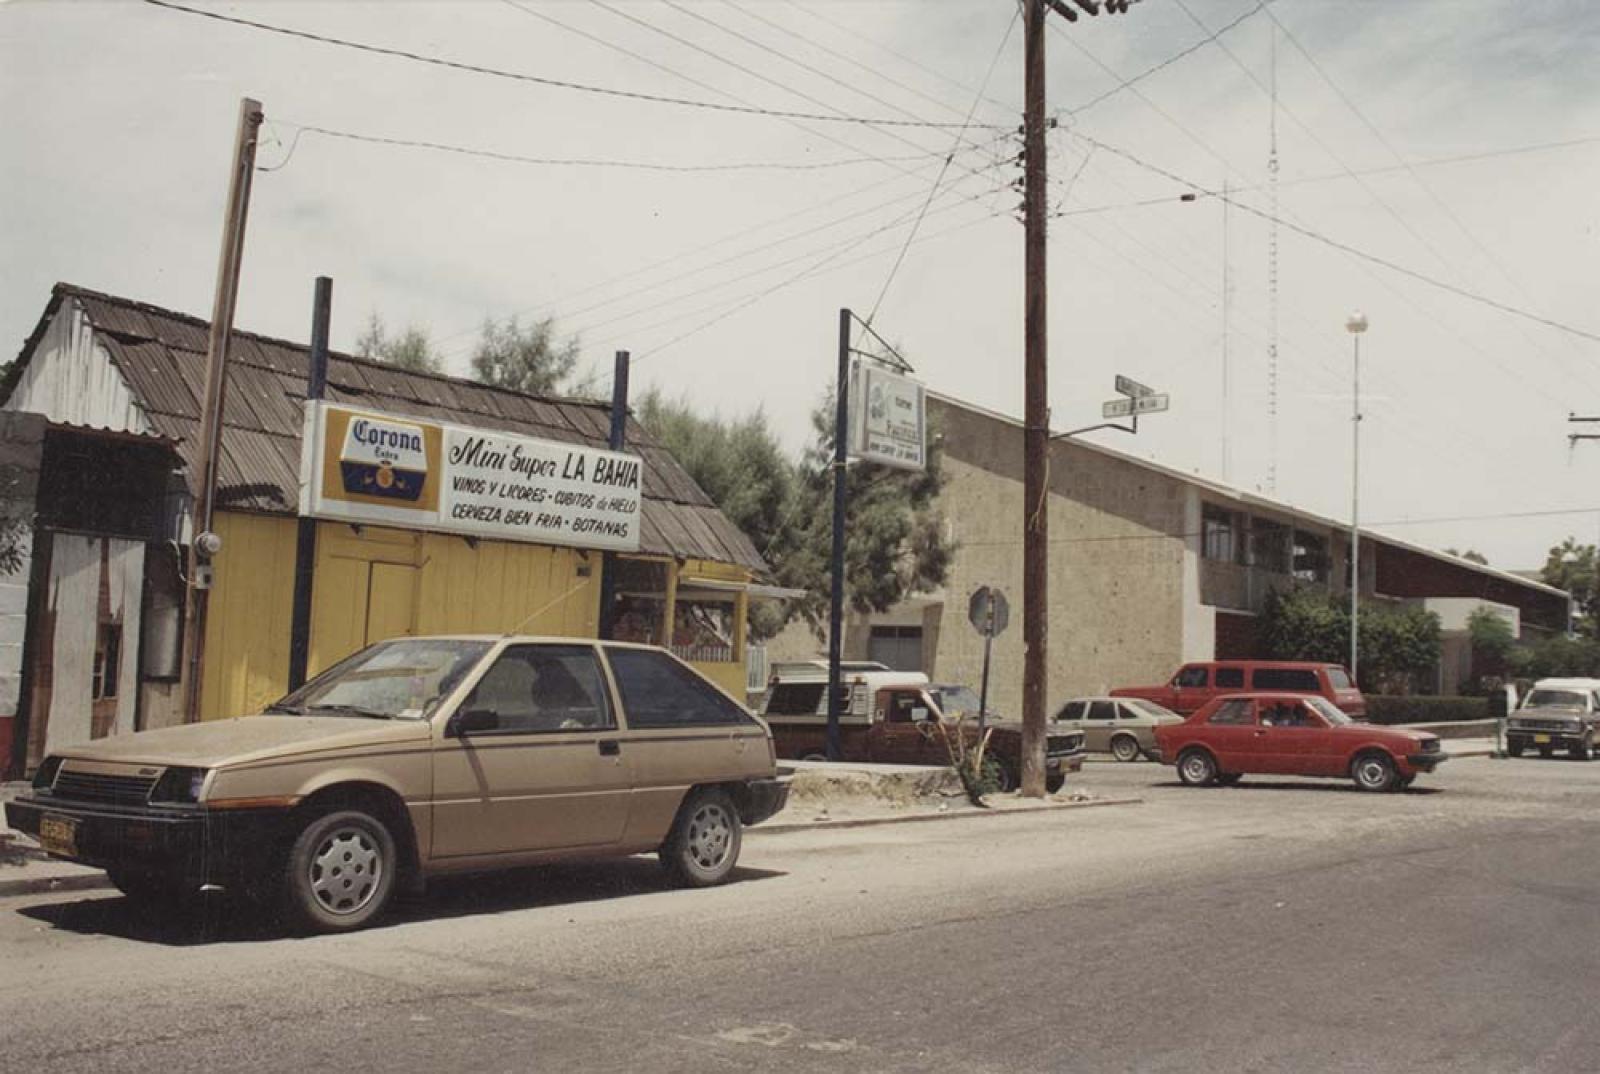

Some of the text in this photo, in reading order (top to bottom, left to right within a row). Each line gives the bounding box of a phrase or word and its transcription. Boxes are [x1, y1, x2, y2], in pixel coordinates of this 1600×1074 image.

[354, 420, 422, 453] Corona
[374, 447, 399, 460] Extra
[449, 436, 639, 489] Mini Super LA BAHIA
[453, 476, 486, 495] VINOS
[489, 482, 498, 496] Y
[499, 484, 547, 502] LICORES
[554, 490, 596, 509] CUBITOS
[608, 498, 637, 513] HIELO
[452, 504, 628, 538] CERVEZA BIEN FRIA BOTANAS
